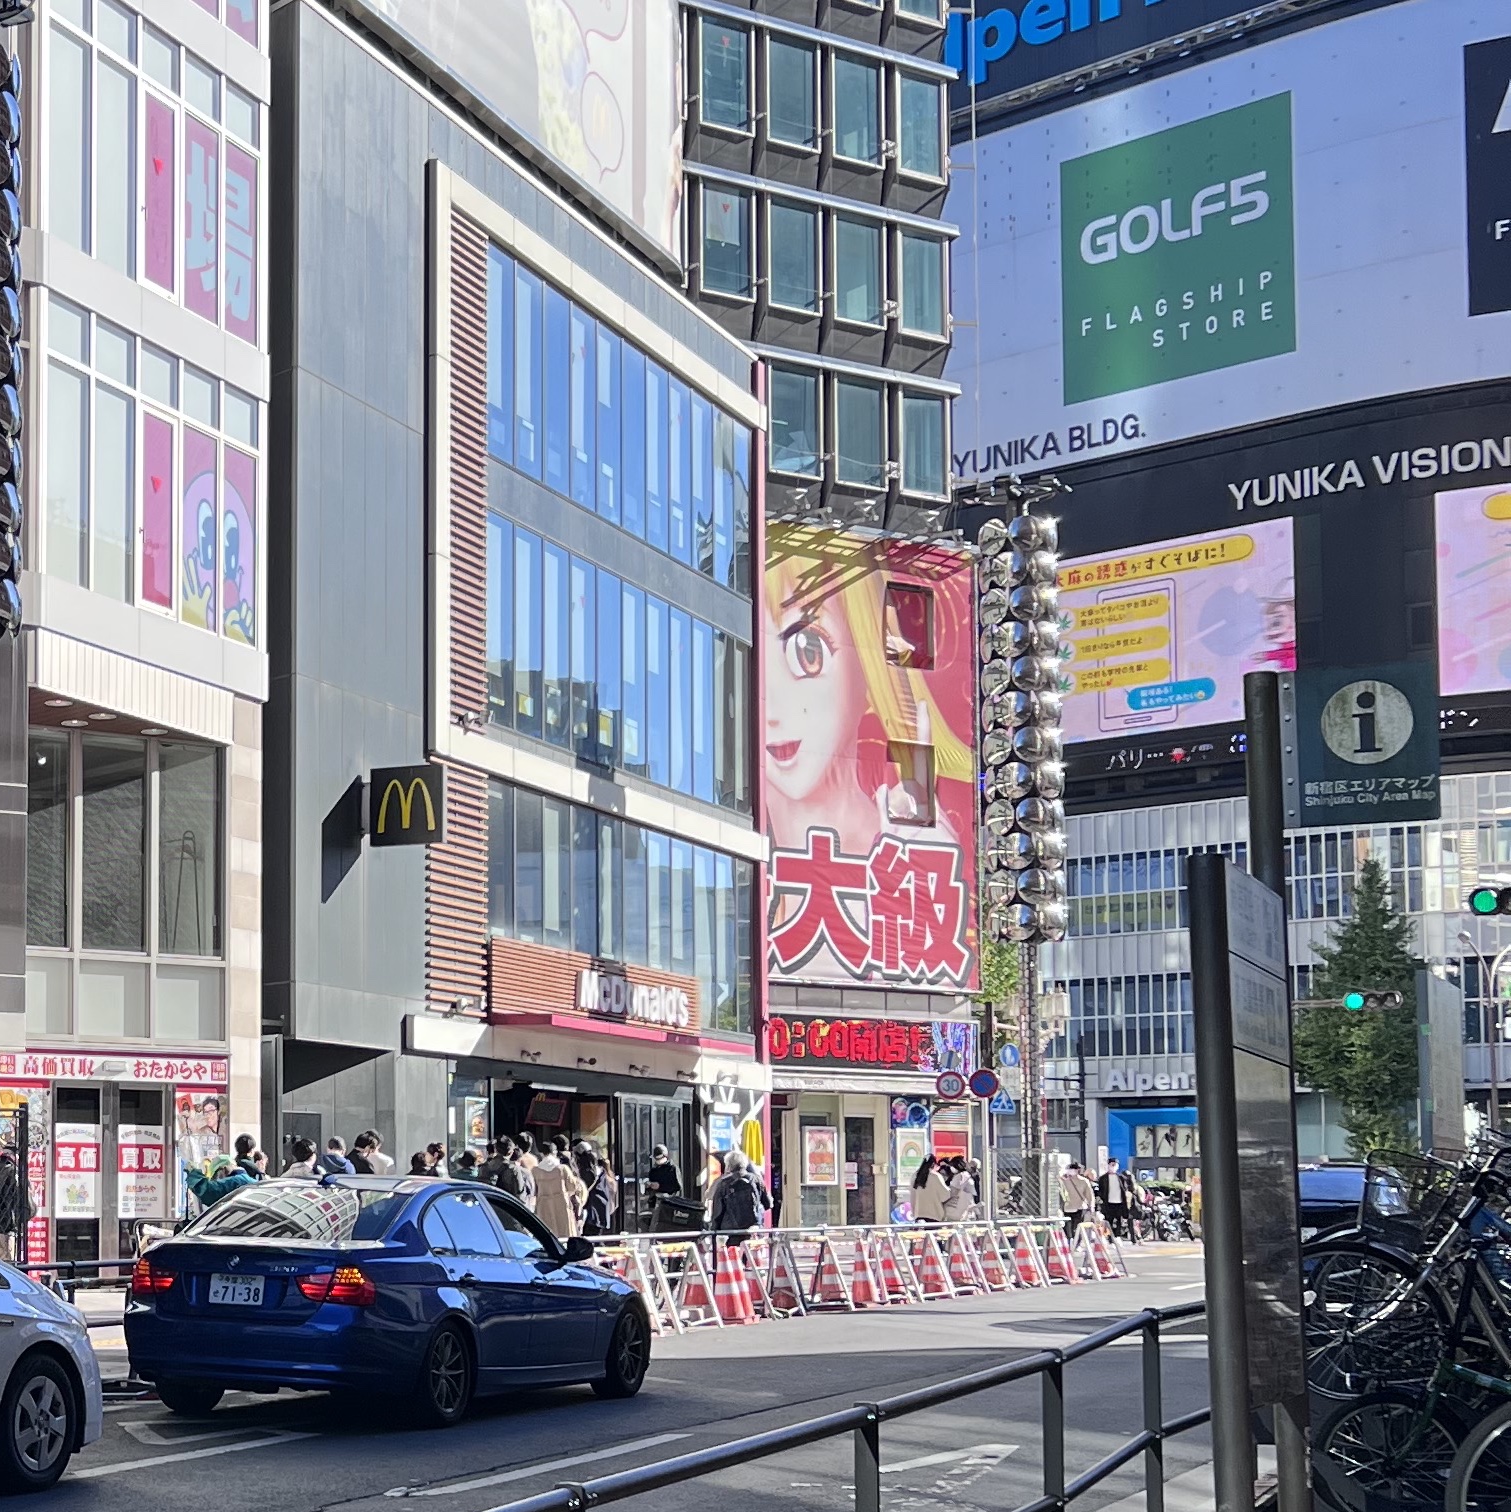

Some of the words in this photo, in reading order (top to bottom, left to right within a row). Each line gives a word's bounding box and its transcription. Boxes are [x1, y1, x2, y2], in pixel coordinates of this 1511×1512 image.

[1080, 170, 1270, 265] GOLF5
[1081, 270, 1273, 336] FLAGSHIP
[1152, 302, 1274, 347] STORE
[954, 434, 1061, 476] YUNIKA
[1069, 416, 1146, 454] BLDG.
[1229, 460, 1364, 511] YUNIKA
[1373, 436, 1511, 483] VISION
[1305, 774, 1436, 796] 新宿区エリアマップ
[1305, 792, 1354, 807] Shinjuku
[1382, 790, 1407, 803] Area
[1411, 788, 1436, 803] Map
[576, 969, 689, 1027] McDonald's
[23, 1057, 95, 1076] 高価買取
[133, 1060, 207, 1080] おたからや
[942, 1078, 960, 1092] 30
[58, 1147, 96, 1168] 高価
[122, 1148, 161, 1170] 買取
[222, 1286, 260, 1302] 71-38
